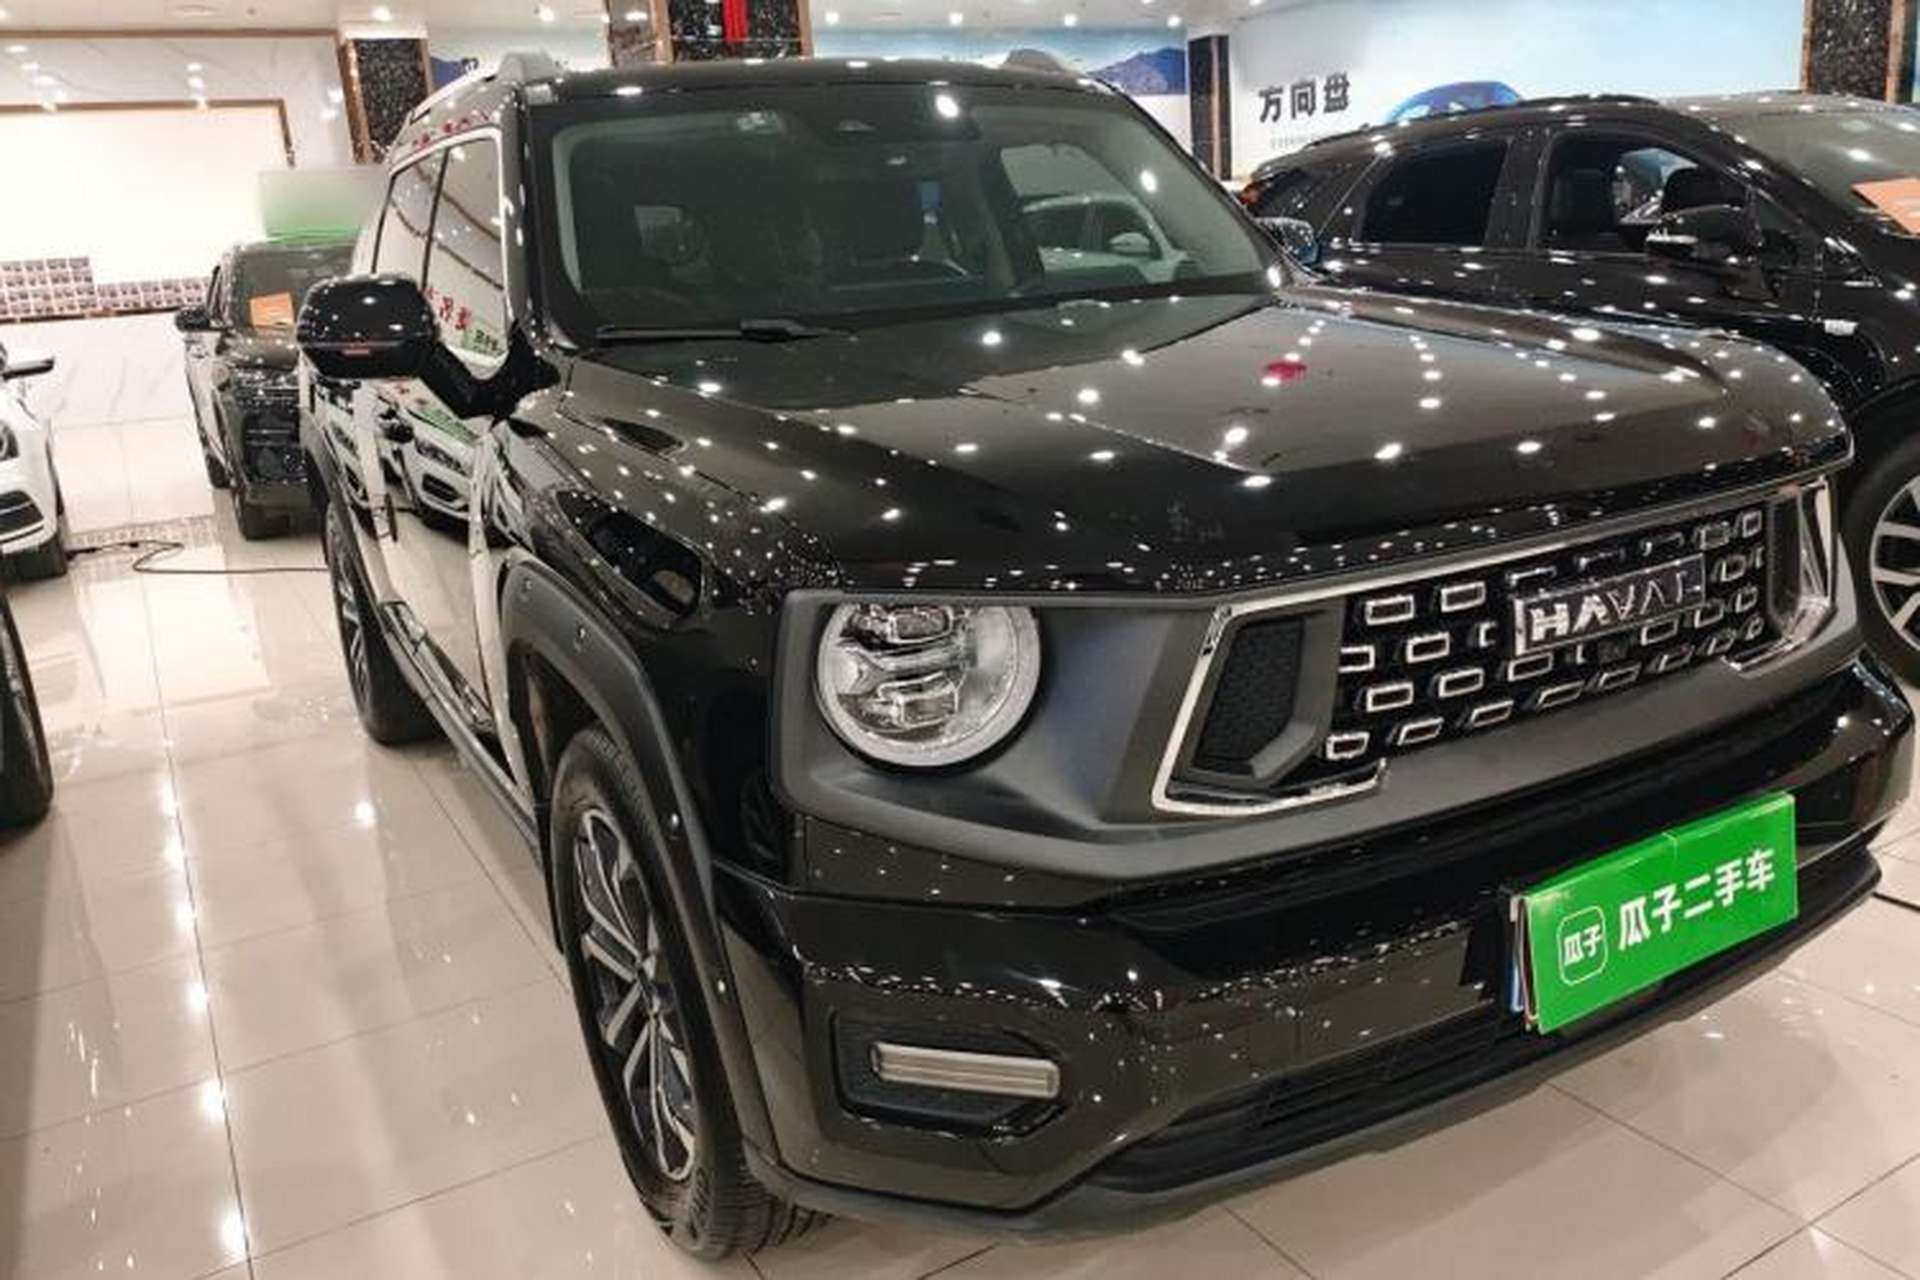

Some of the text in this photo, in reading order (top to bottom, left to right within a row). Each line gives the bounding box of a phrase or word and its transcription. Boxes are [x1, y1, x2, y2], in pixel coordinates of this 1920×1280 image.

[1258, 71, 1350, 123] 方向盘
[1529, 570, 1702, 642] HAVAL
[1618, 848, 1776, 951] 瓜子二手车
[1563, 923, 1602, 967] 瓜子
